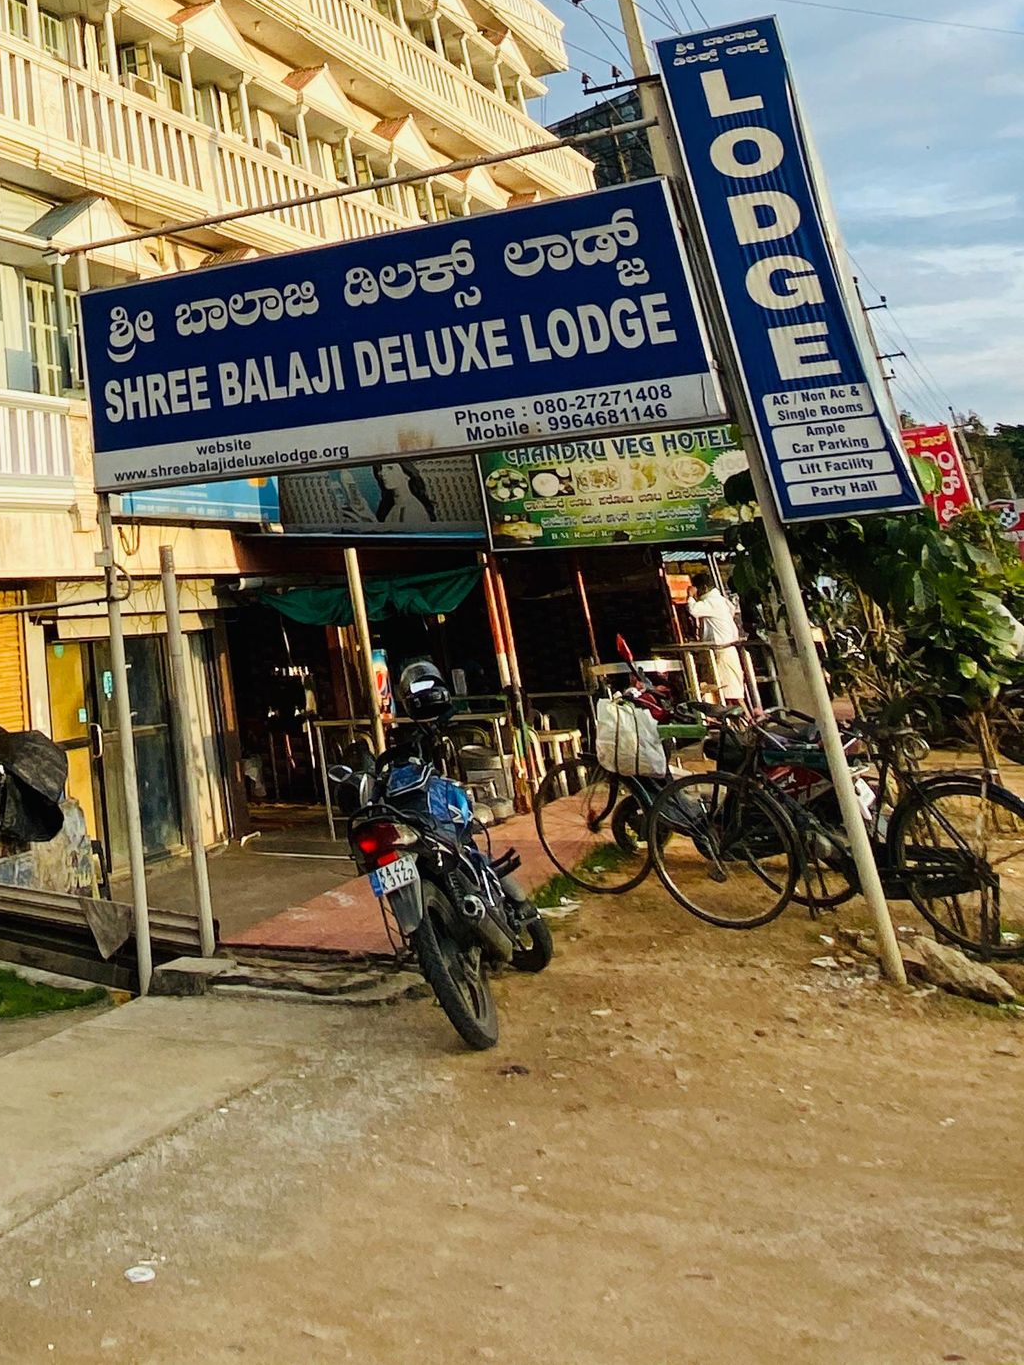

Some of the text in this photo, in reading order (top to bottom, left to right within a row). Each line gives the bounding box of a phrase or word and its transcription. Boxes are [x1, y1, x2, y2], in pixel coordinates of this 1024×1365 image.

[700, 68, 843, 381] LODGE
[107, 208, 651, 363] ಶ್ರೀ ಬಾಲಾಜಿ ಡಿಲಕ್ಸ್ ಲಾಡ್ಜ್
[104, 292, 678, 423] SHREE BALAJI DELUXE LODGE
[454, 406, 515, 426] Phone
[533, 384, 672, 415] 080-27271408
[772, 394, 790, 406] AC
[800, 391, 826, 403] Non
[830, 388, 846, 399] Ac
[850, 386, 860, 397] &
[466, 420, 529, 442] Mobile
[548, 403, 668, 432] 9964681146
[777, 402, 864, 422] Single Rooms
[806, 423, 845, 437] Ample
[196, 439, 252, 456] website
[504, 428, 737, 466] CHANDRU VEG HOTEL
[792, 437, 869, 454] Car Parking
[114, 445, 350, 482] www.shreebalajideluxelodge.org
[799, 457, 874, 475] Lift Facility
[811, 480, 878, 497] Party Hall
